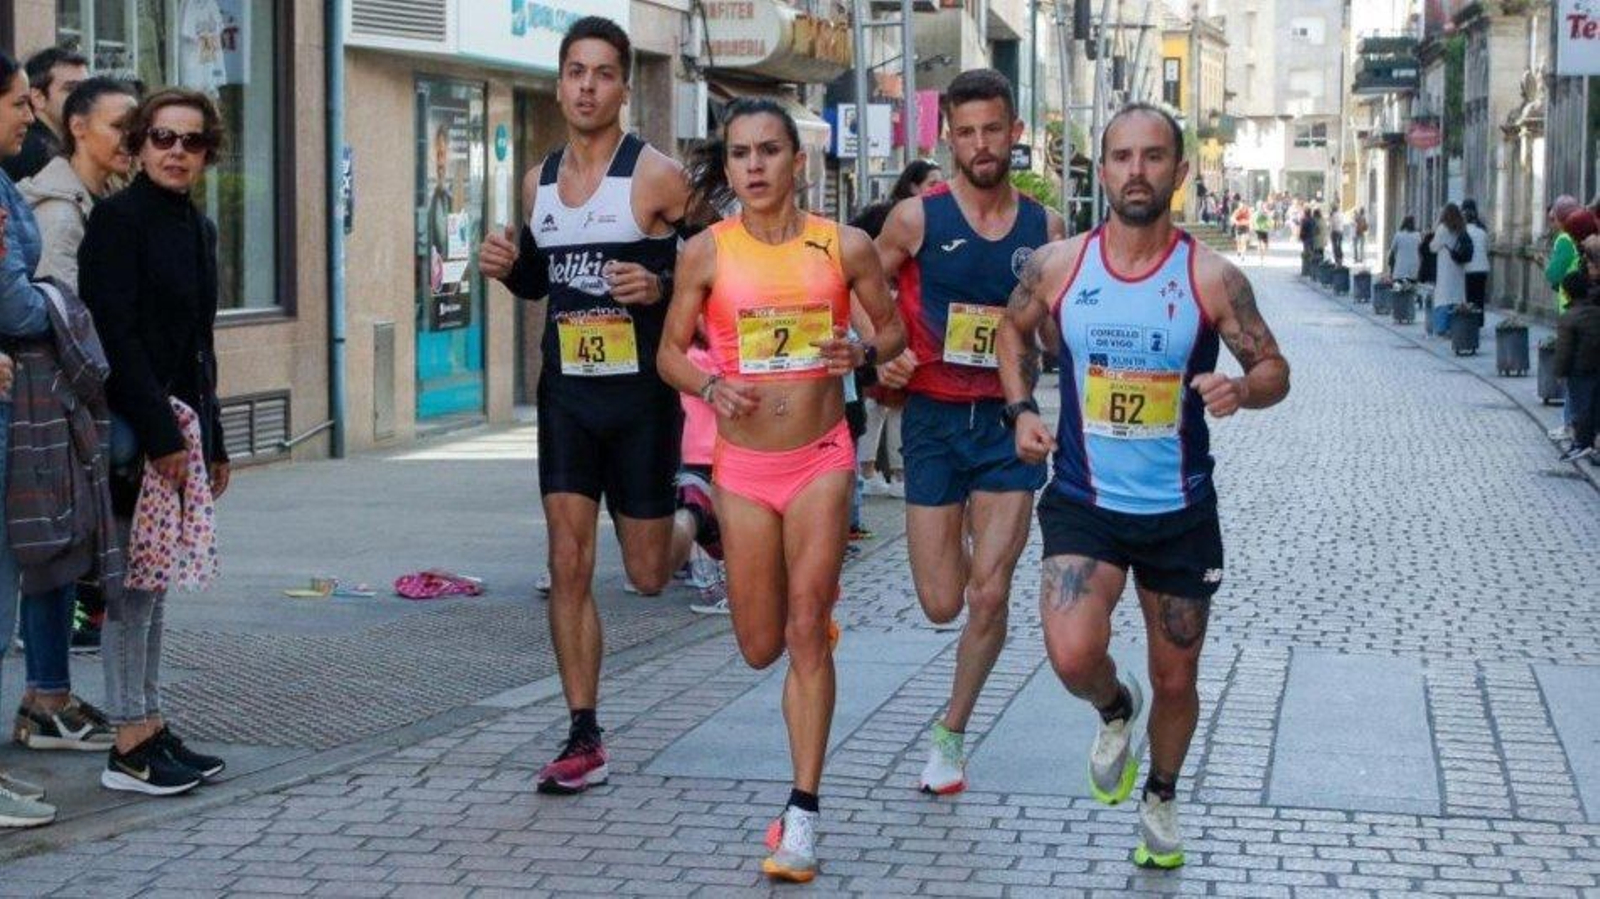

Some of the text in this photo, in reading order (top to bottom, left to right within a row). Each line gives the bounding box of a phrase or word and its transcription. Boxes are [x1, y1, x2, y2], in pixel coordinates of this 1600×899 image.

[1566, 14, 1600, 40] Te
[774, 327, 789, 357] 2
[1090, 329, 1140, 339] CONCELLO
[1111, 340, 1134, 349] VIGO
[578, 335, 605, 362] 43
[1109, 392, 1146, 425] 62
